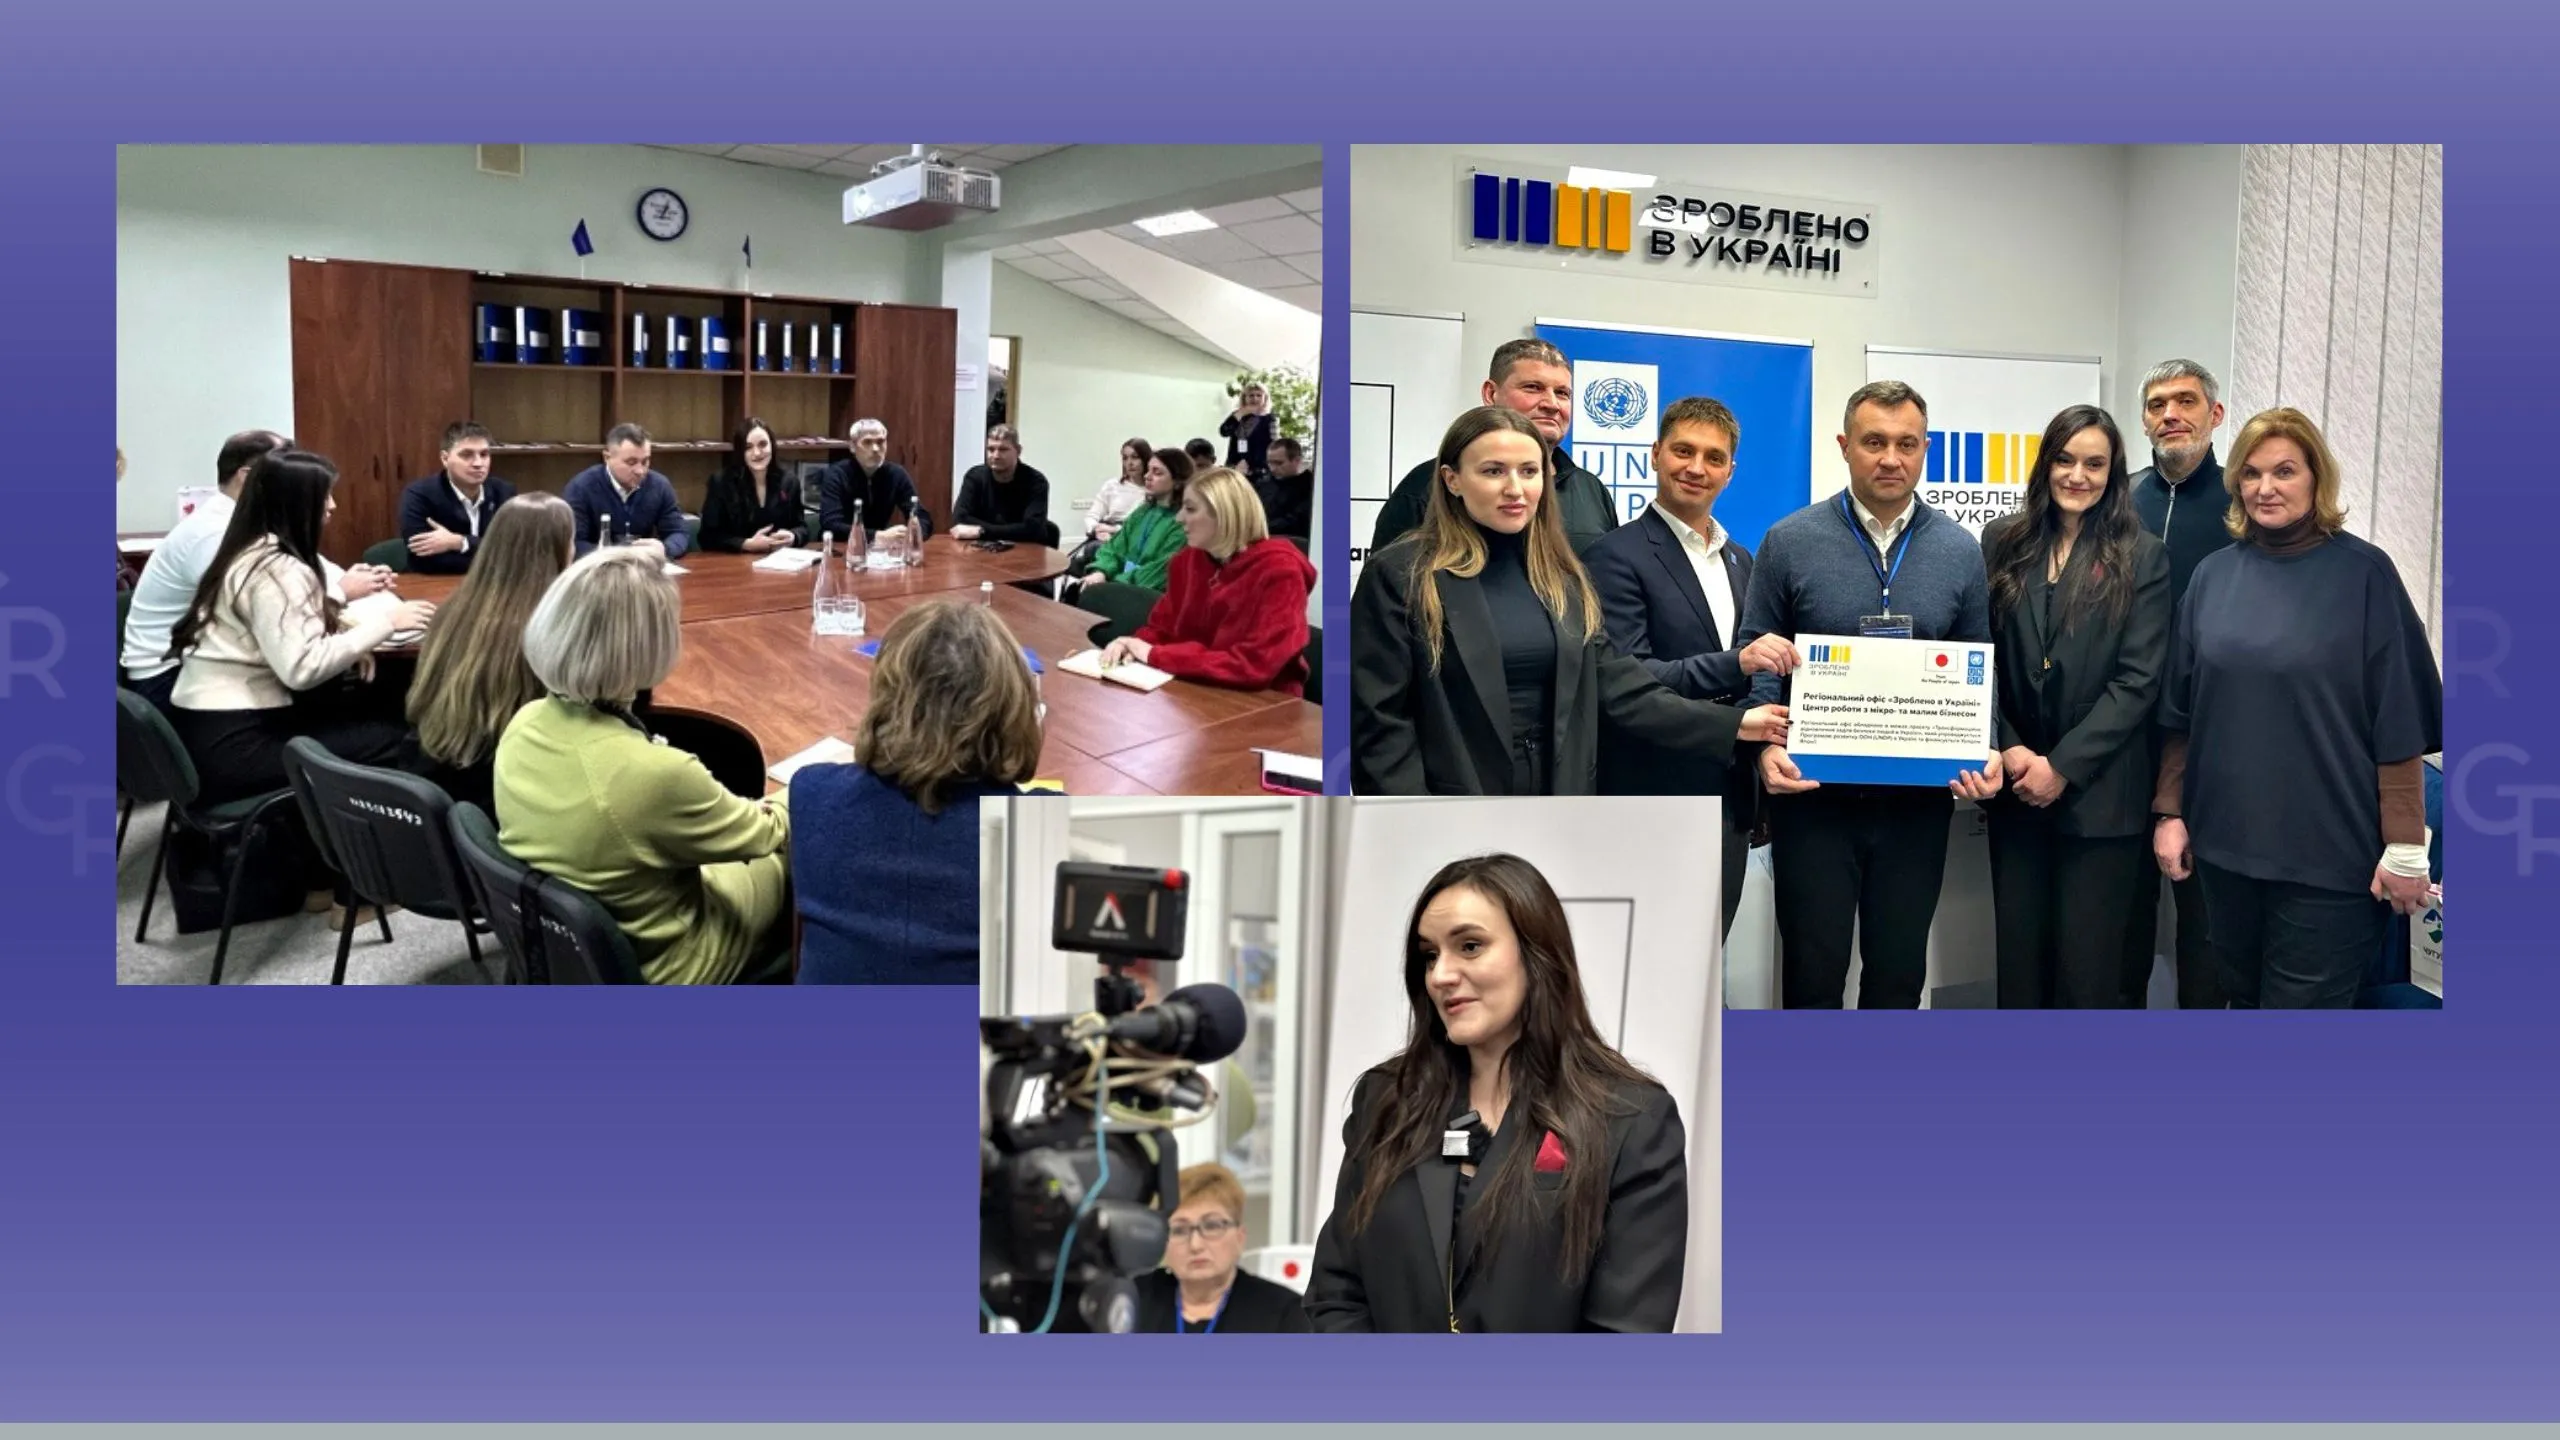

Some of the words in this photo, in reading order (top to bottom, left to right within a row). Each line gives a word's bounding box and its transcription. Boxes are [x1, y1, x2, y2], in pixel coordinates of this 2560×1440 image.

[1652, 194, 1869, 243] ЗРОБЛЕНО
[1651, 229, 1676, 256] В
[1691, 233, 1840, 273] УКРАЇНІ
[1802, 704, 1829, 713] Центр
[1831, 705, 1861, 713] роботи
[1870, 706, 1897, 715] мікро-
[1939, 709, 1976, 717] бізнесом
[1803, 692, 1865, 702] Регіональний
[1866, 695, 1886, 703] офіс
[1888, 696, 1936, 704] «Зроблено
